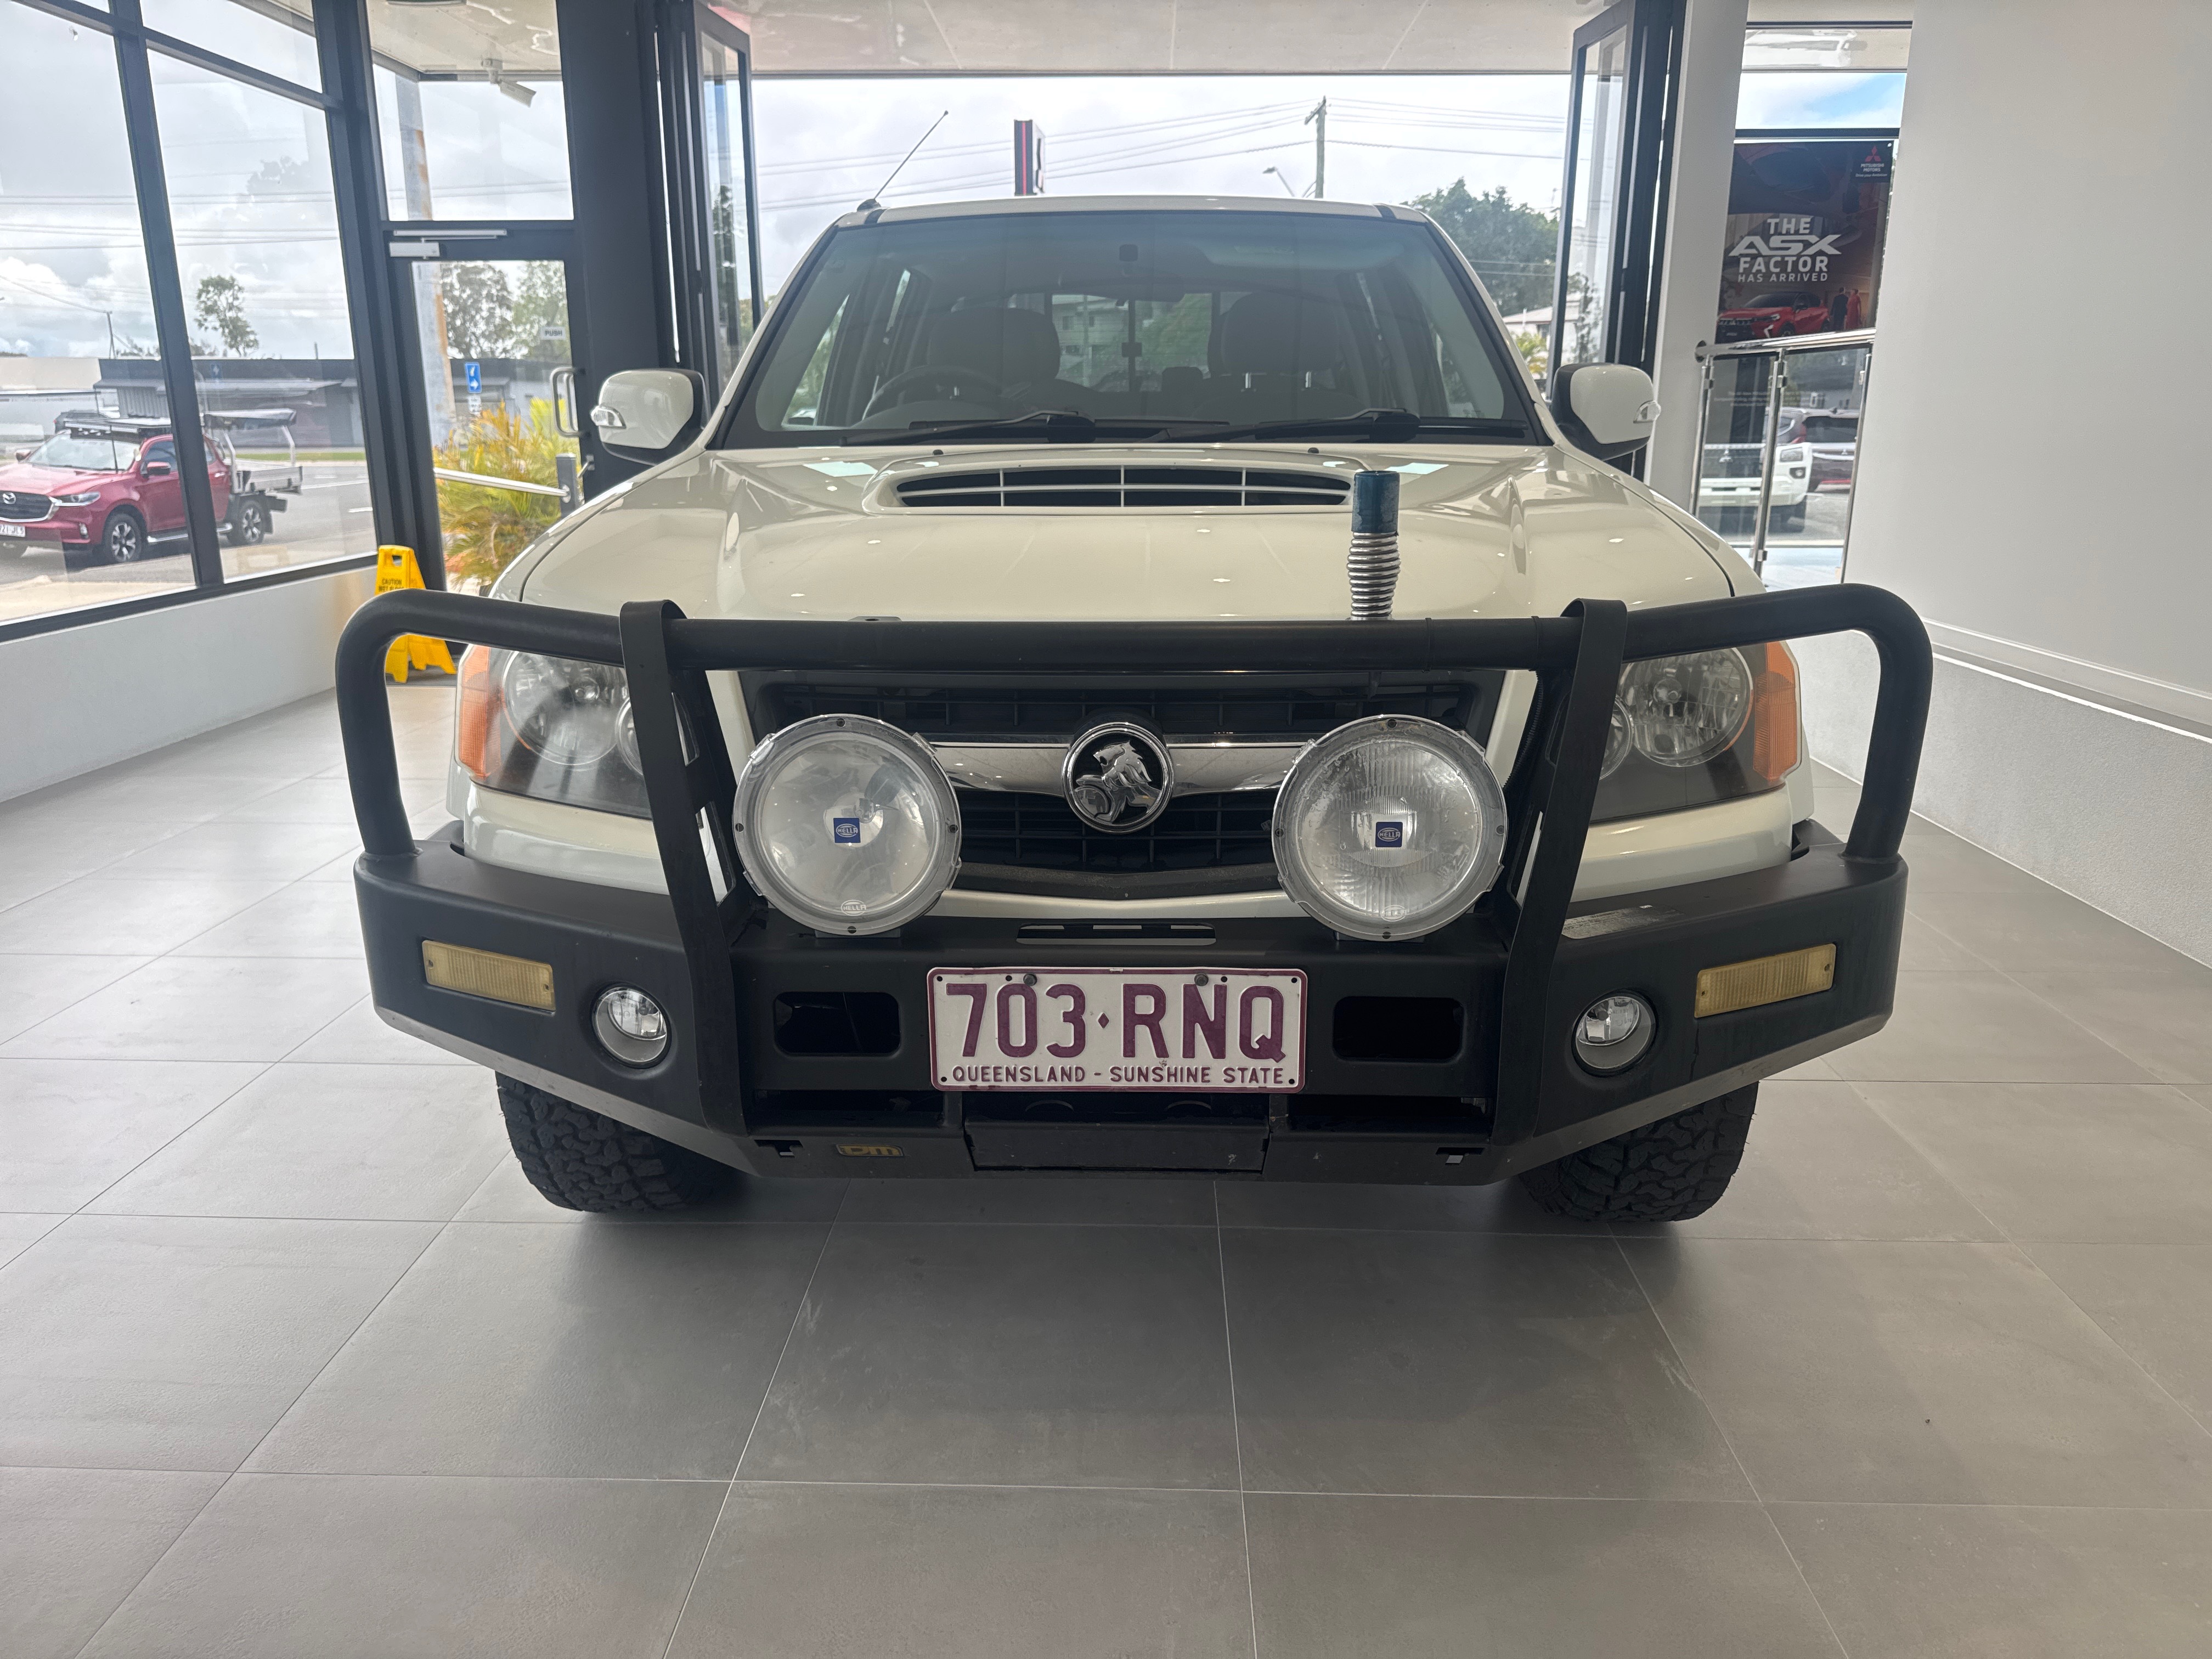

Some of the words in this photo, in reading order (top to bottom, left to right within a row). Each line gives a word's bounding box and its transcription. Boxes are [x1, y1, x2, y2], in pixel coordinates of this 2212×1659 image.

[1767, 218, 1810, 234] THE
[1729, 234, 1842, 256] ASX
[1739, 256, 1829, 273] FACTOR
[1738, 274, 1763, 283] HAS
[1769, 273, 1828, 281] ARRIVED
[952, 1066, 1086, 1082] QUEENSLAND
[1110, 1066, 1211, 1082] SUNSHINE
[1223, 1068, 1283, 1083] STATE
